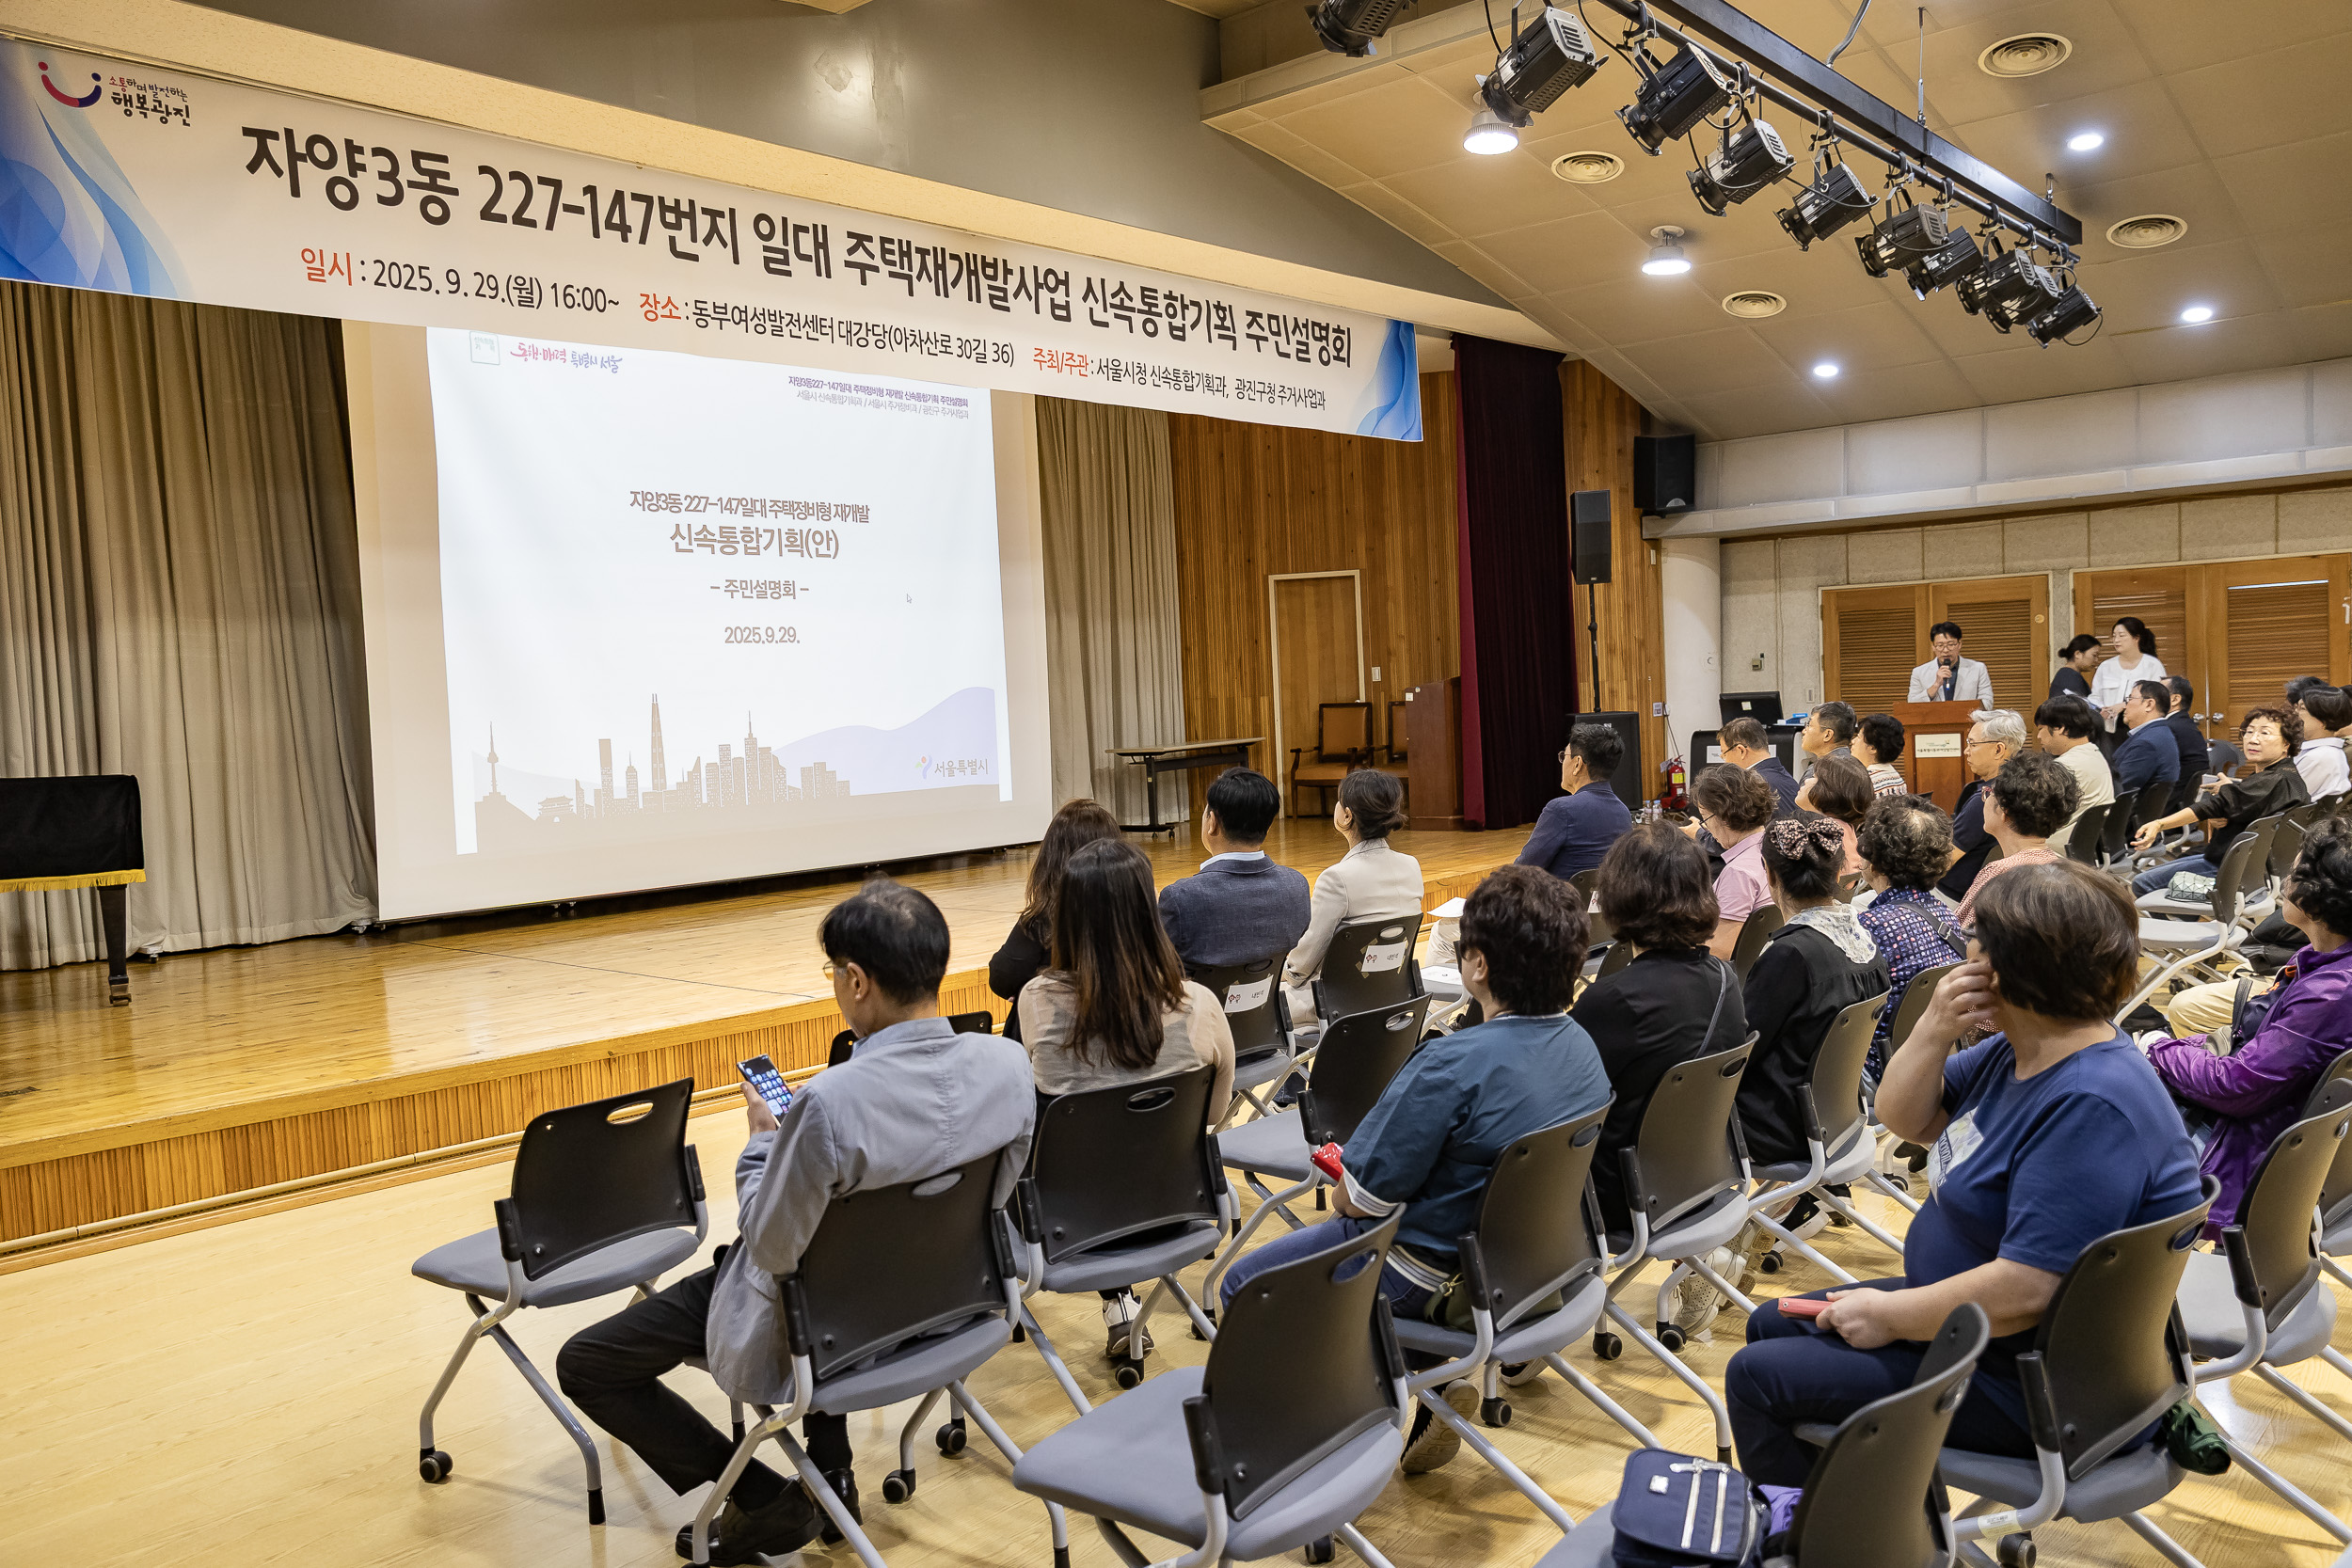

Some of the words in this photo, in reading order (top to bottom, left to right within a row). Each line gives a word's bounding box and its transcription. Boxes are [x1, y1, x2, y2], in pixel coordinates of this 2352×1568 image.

[109, 76, 147, 93] 소통하며
[149, 84, 188, 103] 발전하는
[111, 92, 191, 127] 행복광진
[241, 126, 460, 226] 자양3동
[477, 165, 741, 264] 227-147번지
[753, 213, 832, 278] 일대
[844, 230, 1072, 323] 주택재개발사업
[1082, 277, 1237, 352] 신속통합기획
[1245, 309, 1352, 368] 주민설명회
[550, 282, 620, 313] 16:00~
[837, 320, 953, 356] 대강당(아차산로
[957, 339, 988, 364] 30길
[992, 342, 1015, 368] 36)
[1150, 364, 1230, 399] 신속통합기획과,
[1235, 378, 1277, 405] 광진구청
[1278, 385, 1327, 412] 주거사업과
[570, 351, 598, 368] 특별시
[600, 355, 623, 373] 서울
[629, 490, 683, 515] 자양3동
[684, 494, 767, 517] 227-147일대
[768, 499, 832, 522] 주택정비형
[834, 502, 870, 524] 재개발
[670, 523, 840, 560] 신속통합기획(안)
[723, 578, 797, 600] 주민설명회
[724, 626, 801, 644] 2025.9.29.
[934, 758, 989, 778] 서울특별시
